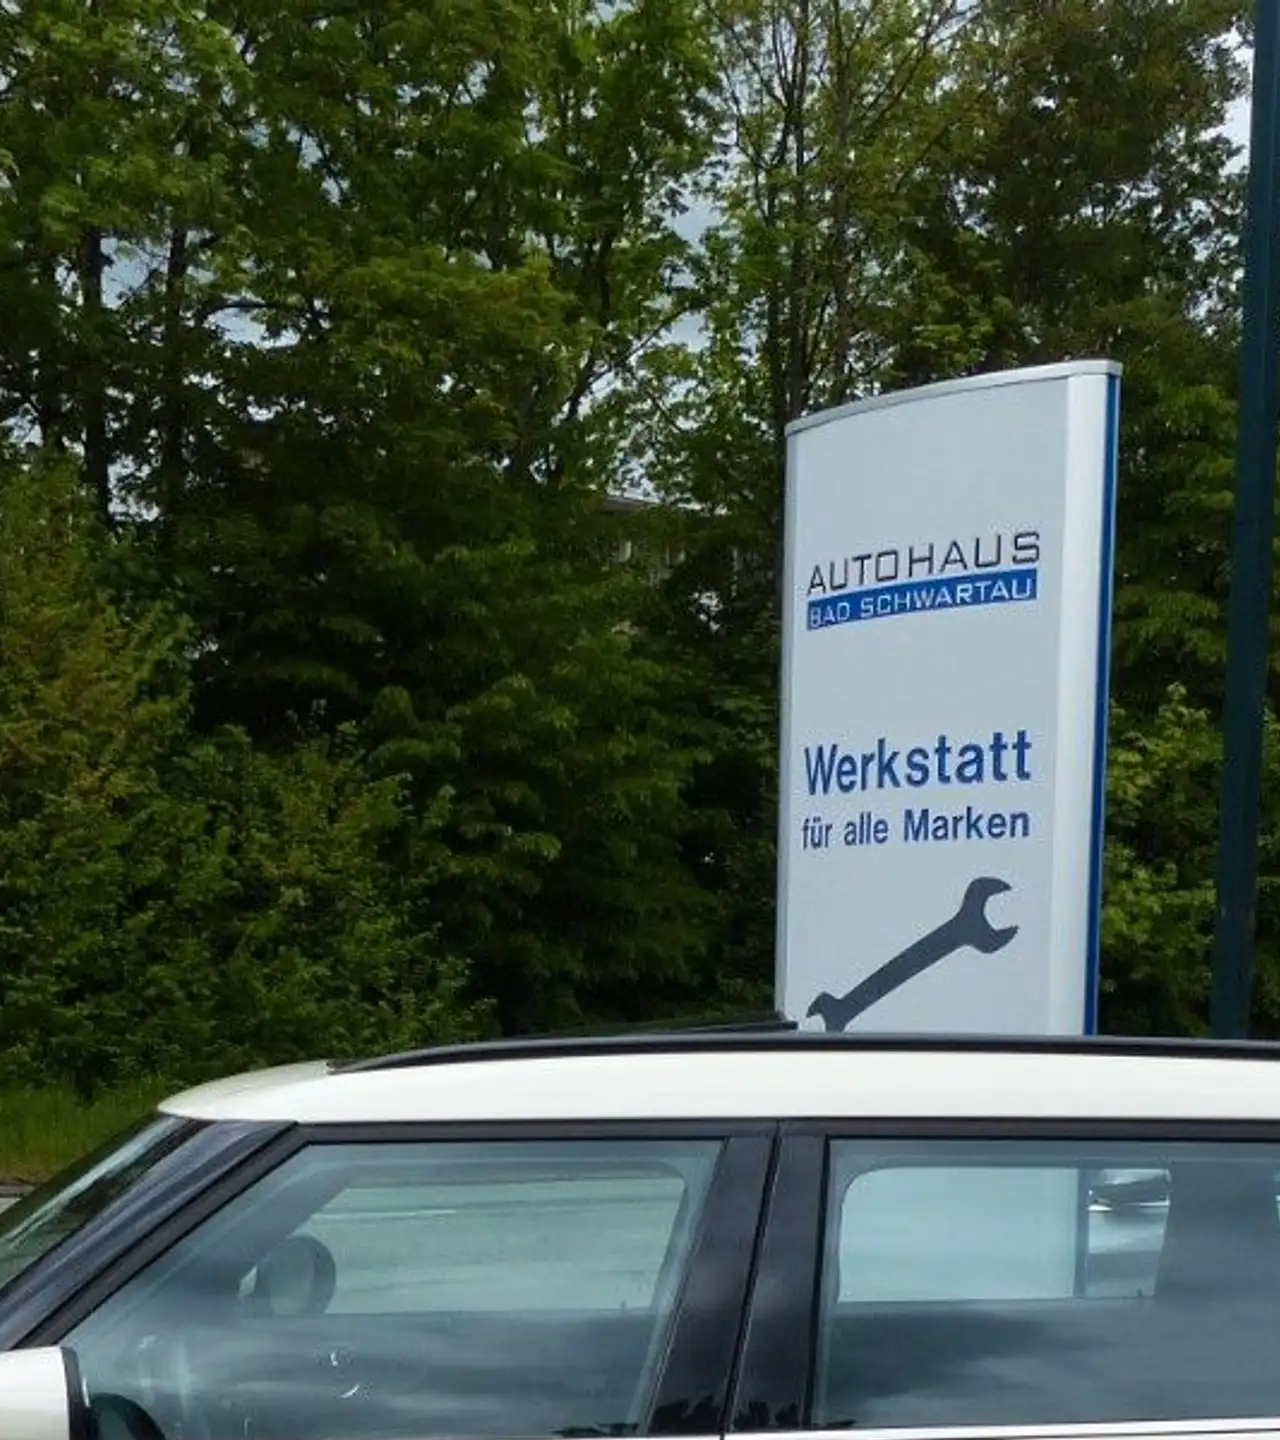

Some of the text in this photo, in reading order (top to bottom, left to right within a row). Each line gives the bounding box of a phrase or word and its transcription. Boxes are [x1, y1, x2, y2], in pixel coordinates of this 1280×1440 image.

[806, 531, 1041, 596] AUTOHAUS
[809, 577, 1032, 629] BAD SCHWARTAU
[804, 729, 1033, 796] Werkstatt
[801, 806, 1030, 850] für alle Marken
